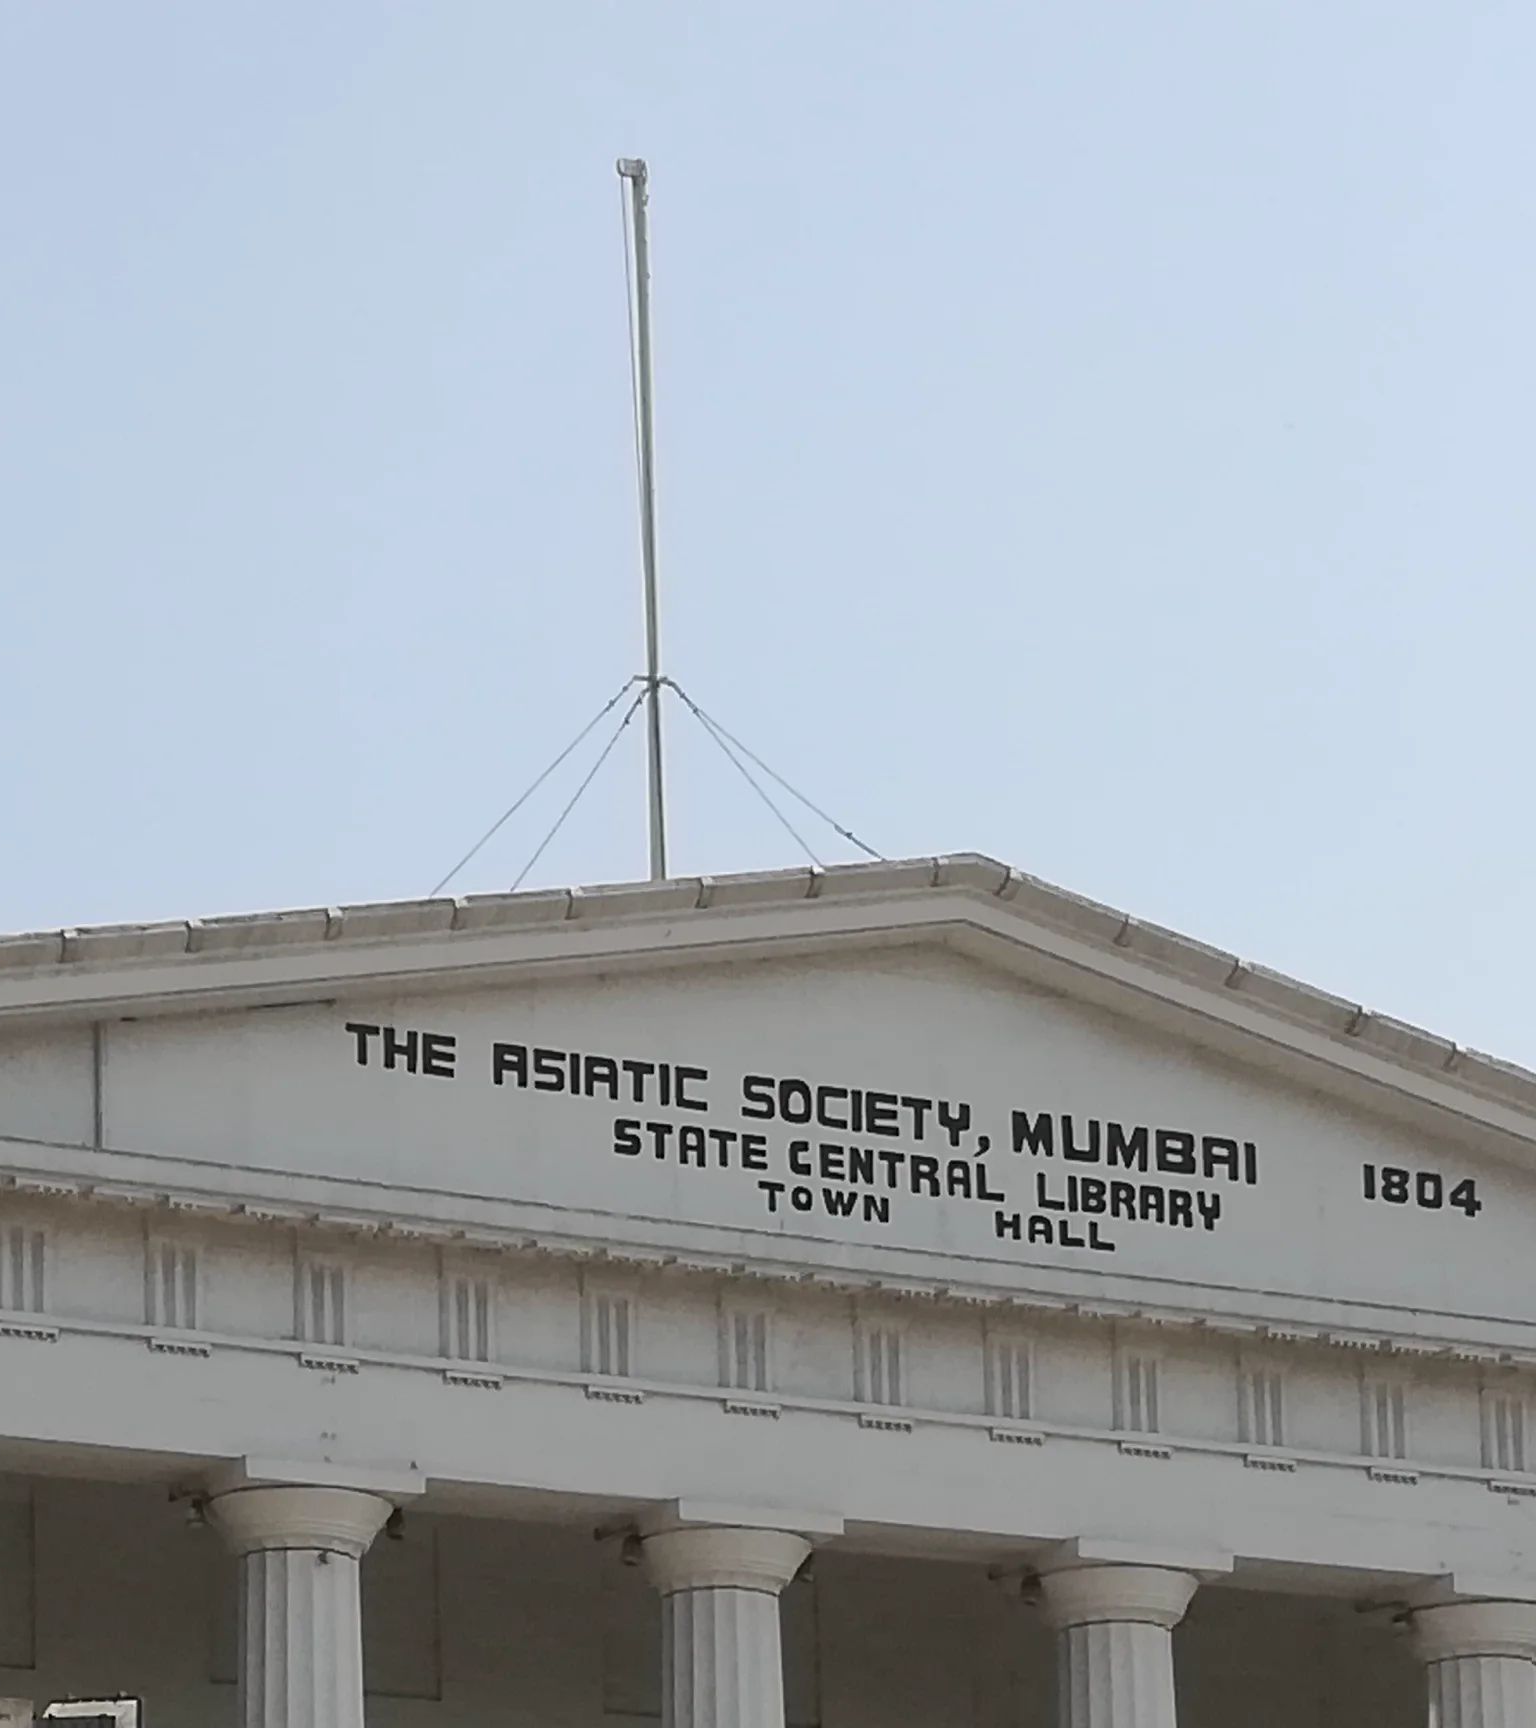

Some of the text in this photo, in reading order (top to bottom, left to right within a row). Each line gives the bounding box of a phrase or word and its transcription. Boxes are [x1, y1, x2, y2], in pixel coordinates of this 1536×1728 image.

[344, 1022, 1257, 1185] THE ASIATIC SOCIETY, MUMBAI
[613, 1118, 1221, 1231] STATE CENTRAL LIBRARY
[757, 1180, 1116, 1252] TOWN HALL
[1363, 1163, 1482, 1218] 1804
